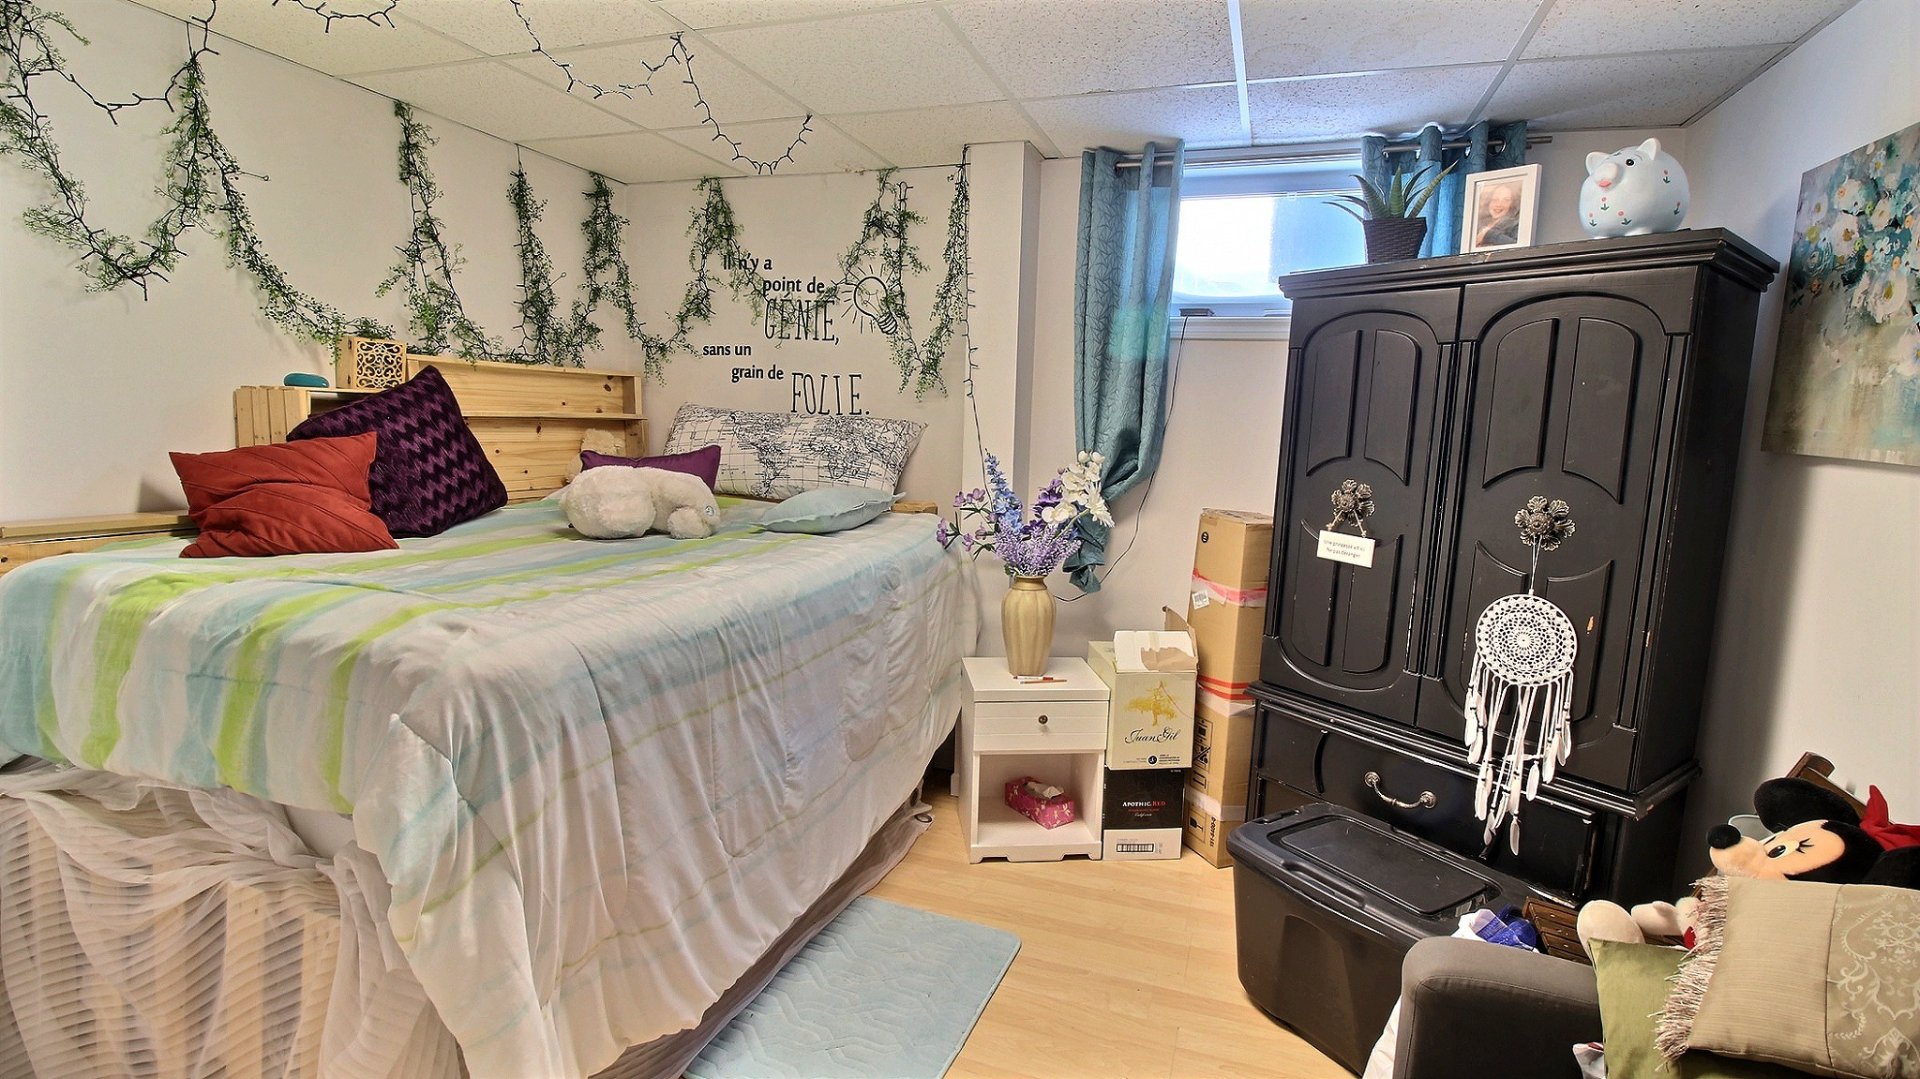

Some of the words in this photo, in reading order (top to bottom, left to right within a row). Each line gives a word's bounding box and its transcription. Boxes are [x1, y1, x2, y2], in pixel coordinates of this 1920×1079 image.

[738, 252, 759, 275] n'y
[763, 258, 773, 270] a
[763, 276, 802, 297] point
[806, 276, 825, 293] de
[764, 292, 839, 345] GÉNIE,
[702, 344, 731, 356] sans
[734, 344, 752, 356] un
[731, 364, 764, 383] grain
[767, 364, 784, 380] de
[791, 372, 871, 416] FOLIE.
[1125, 728, 1158, 744] Juan
